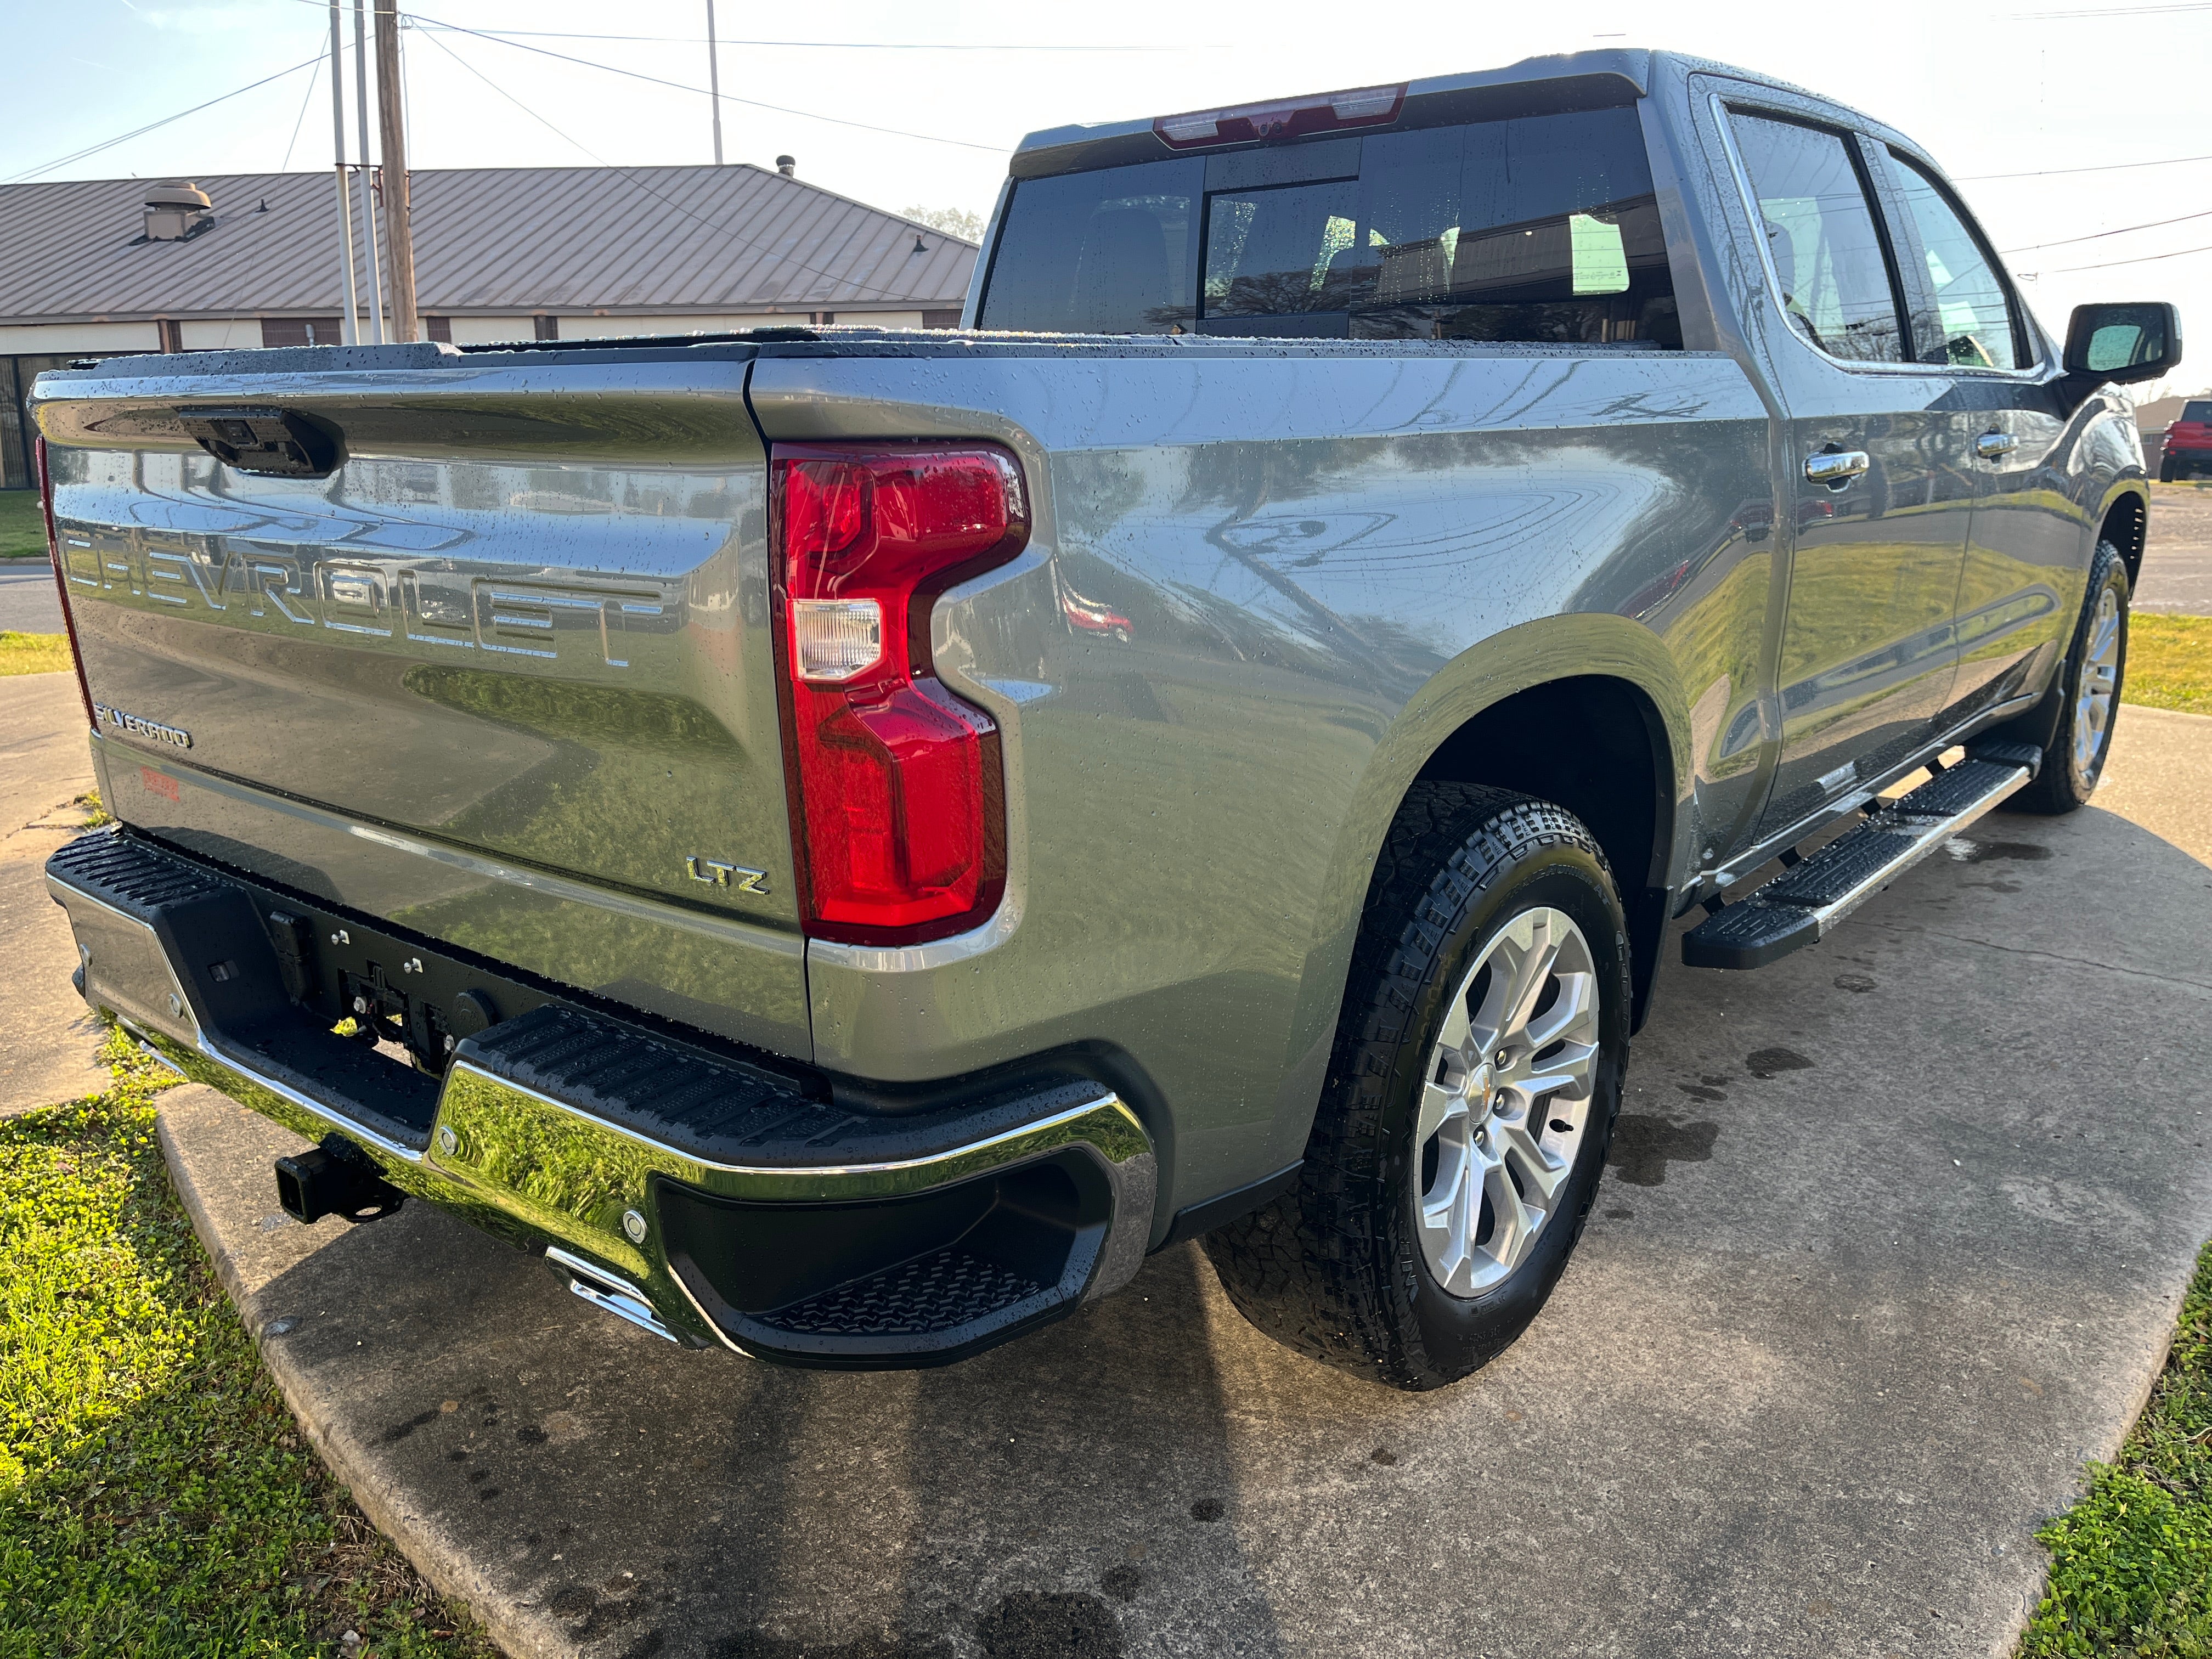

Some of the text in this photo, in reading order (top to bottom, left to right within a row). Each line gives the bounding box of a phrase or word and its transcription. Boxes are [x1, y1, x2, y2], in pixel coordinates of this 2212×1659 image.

[61, 529, 662, 668] CHEVROLET
[93, 702, 195, 749] SILVERADO
[686, 855, 770, 895] LTZ
[1593, 884, 1611, 906] AT
